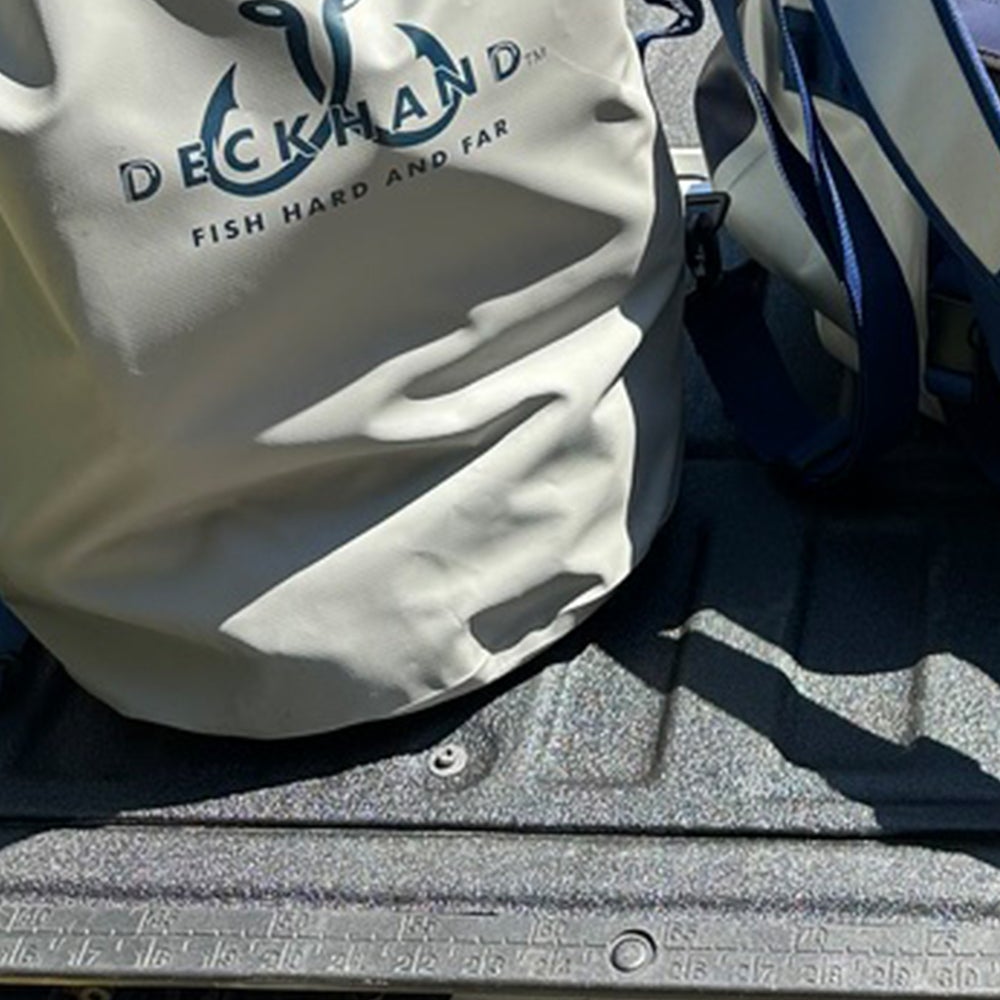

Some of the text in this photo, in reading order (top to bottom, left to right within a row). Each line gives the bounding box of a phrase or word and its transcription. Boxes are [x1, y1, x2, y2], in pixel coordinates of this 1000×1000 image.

[118, 38, 522, 203] DECKHAND
[191, 119, 509, 248] FISH HARD AND FAR
